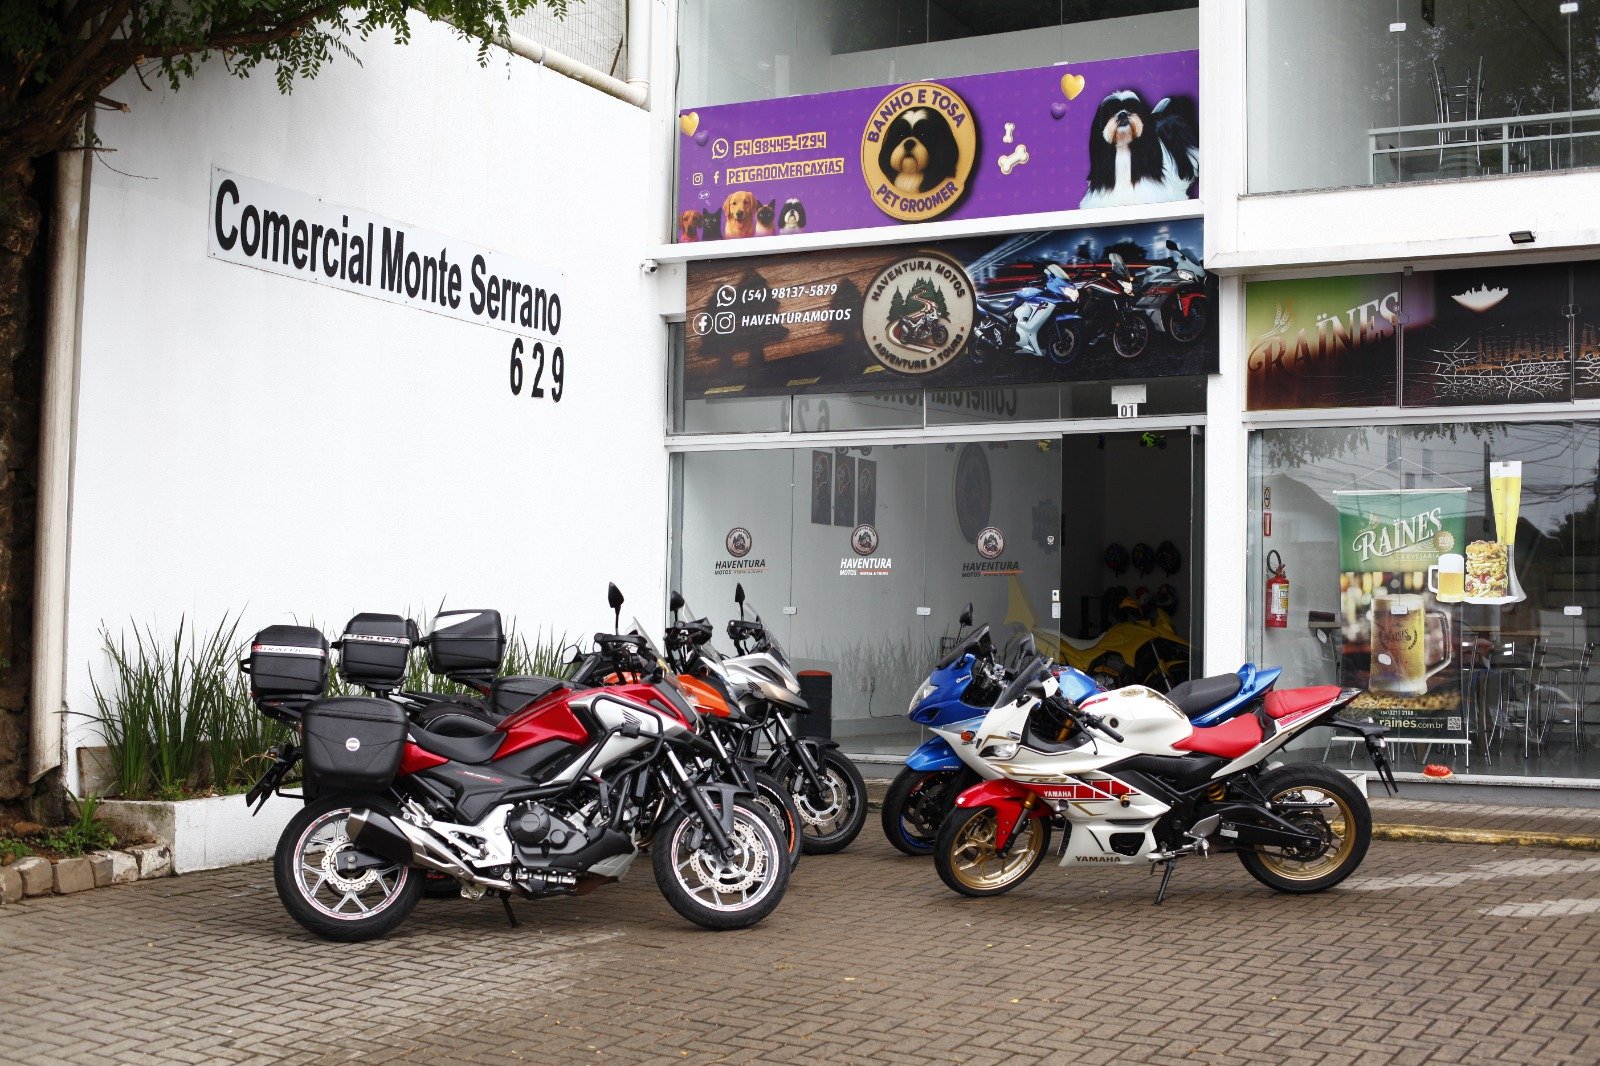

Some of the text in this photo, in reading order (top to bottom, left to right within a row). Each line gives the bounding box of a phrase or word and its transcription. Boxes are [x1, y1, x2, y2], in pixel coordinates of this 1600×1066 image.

[867, 89, 966, 143] BANHO E TOSA
[734, 140, 752, 157] 54
[876, 181, 958, 213] PET GROOMER
[215, 178, 562, 336] Comercial Monte Serrano
[871, 260, 966, 302] HAVENTURA MOTOS
[741, 283, 838, 303] (54) 98137-5879
[741, 308, 852, 327] HAVENTURAMOTOS
[875, 342, 928, 369] ADVENTURE
[937, 333, 963, 361] TOURS
[1121, 404, 1134, 418] 01
[715, 559, 766, 570] HAVENTURA
[840, 558, 892, 569] HAVENTURA
[962, 561, 1019, 572] HAVENTURA
[1043, 790, 1072, 798] YAMAHA
[1075, 855, 1121, 863] YAMAHA
